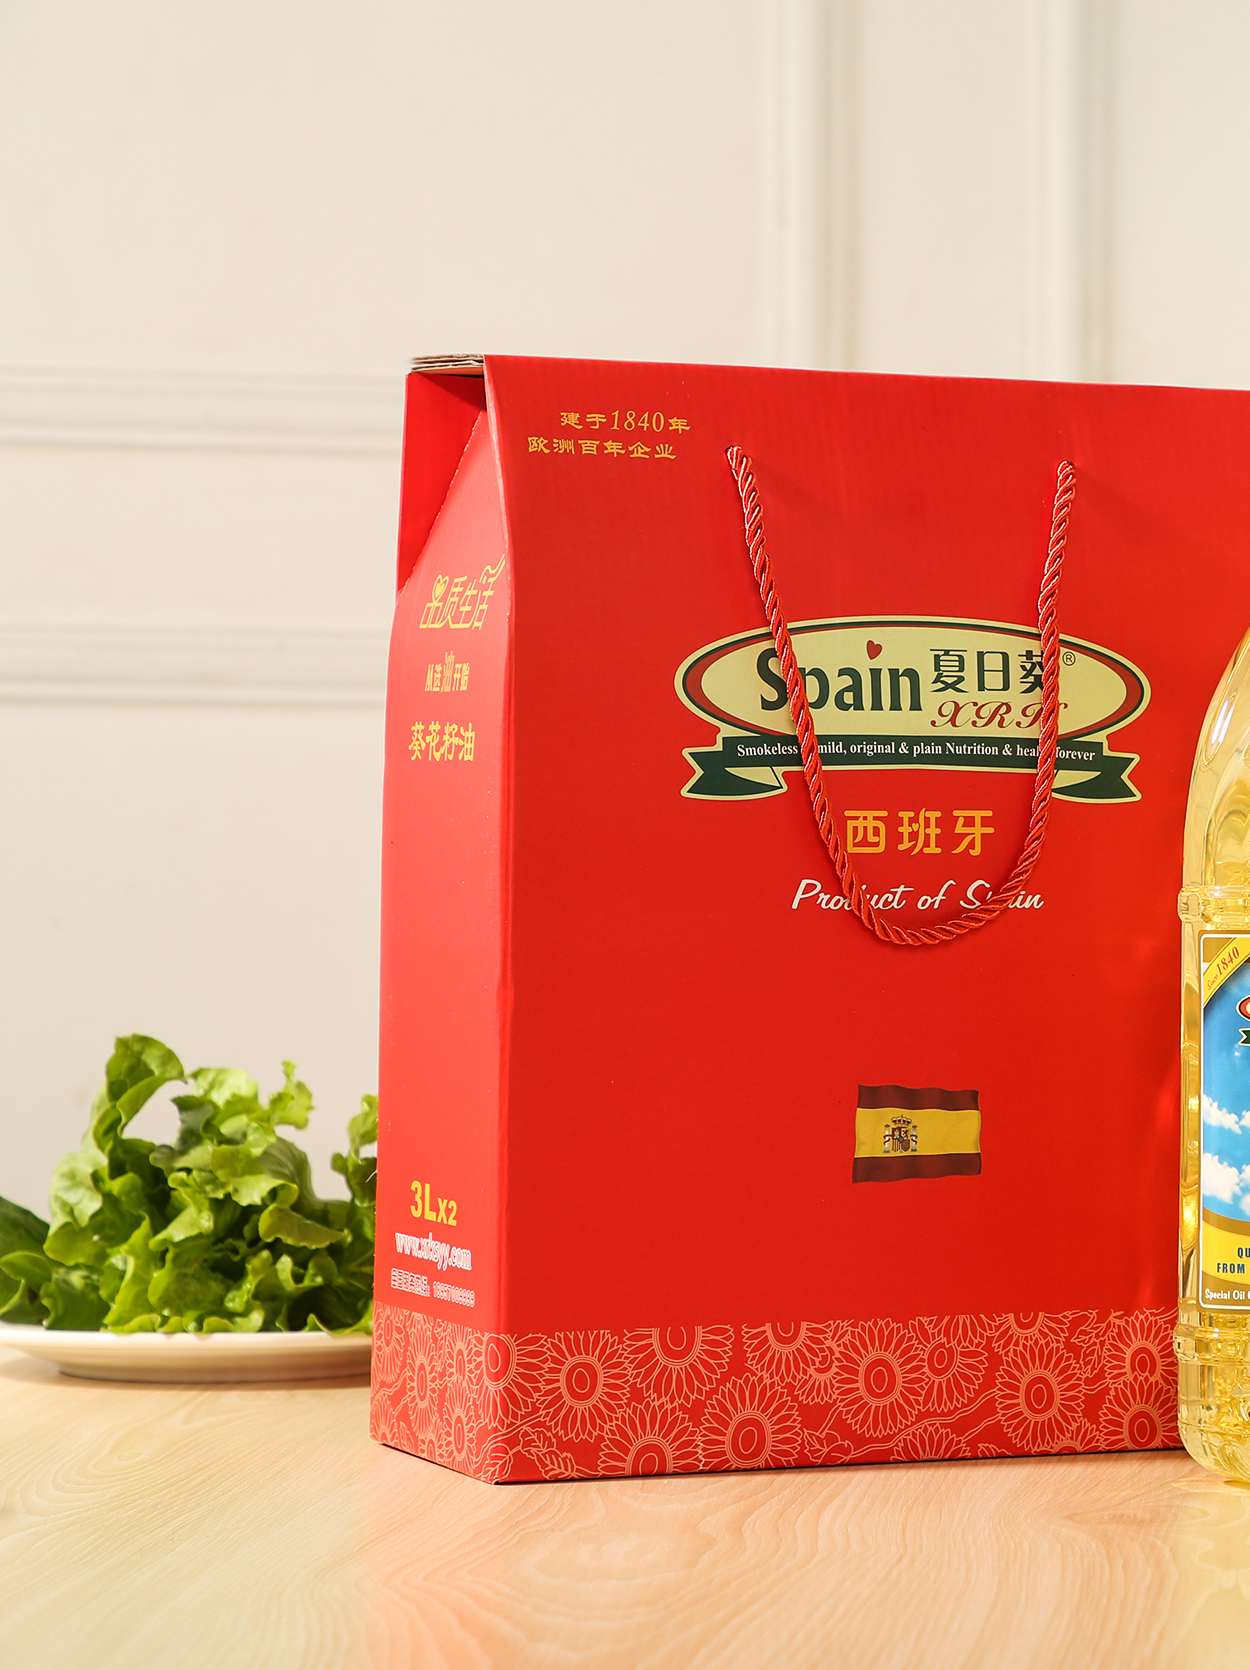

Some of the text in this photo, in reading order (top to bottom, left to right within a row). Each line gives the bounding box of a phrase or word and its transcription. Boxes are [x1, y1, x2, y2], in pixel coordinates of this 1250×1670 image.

[560, 410, 691, 434] 建于1840年
[528, 436, 677, 459] 欧洲百年企业
[419, 553, 506, 630] 品质生活
[409, 721, 476, 761] 葵花籽油
[737, 742, 798, 757] Smokeless
[850, 741, 896, 756] original
[898, 742, 911, 755] &
[912, 742, 942, 758] plain
[945, 742, 999, 756] Nutrition
[1001, 743, 1014, 756] &
[844, 807, 995, 857] 西班牙
[917, 879, 957, 910] of
[1216, 946, 1240, 976] 1840
[1216, 1262, 1246, 1274] FROM
[1204, 1288, 1231, 1301] Special
[1232, 1289, 1246, 1301] Oil
